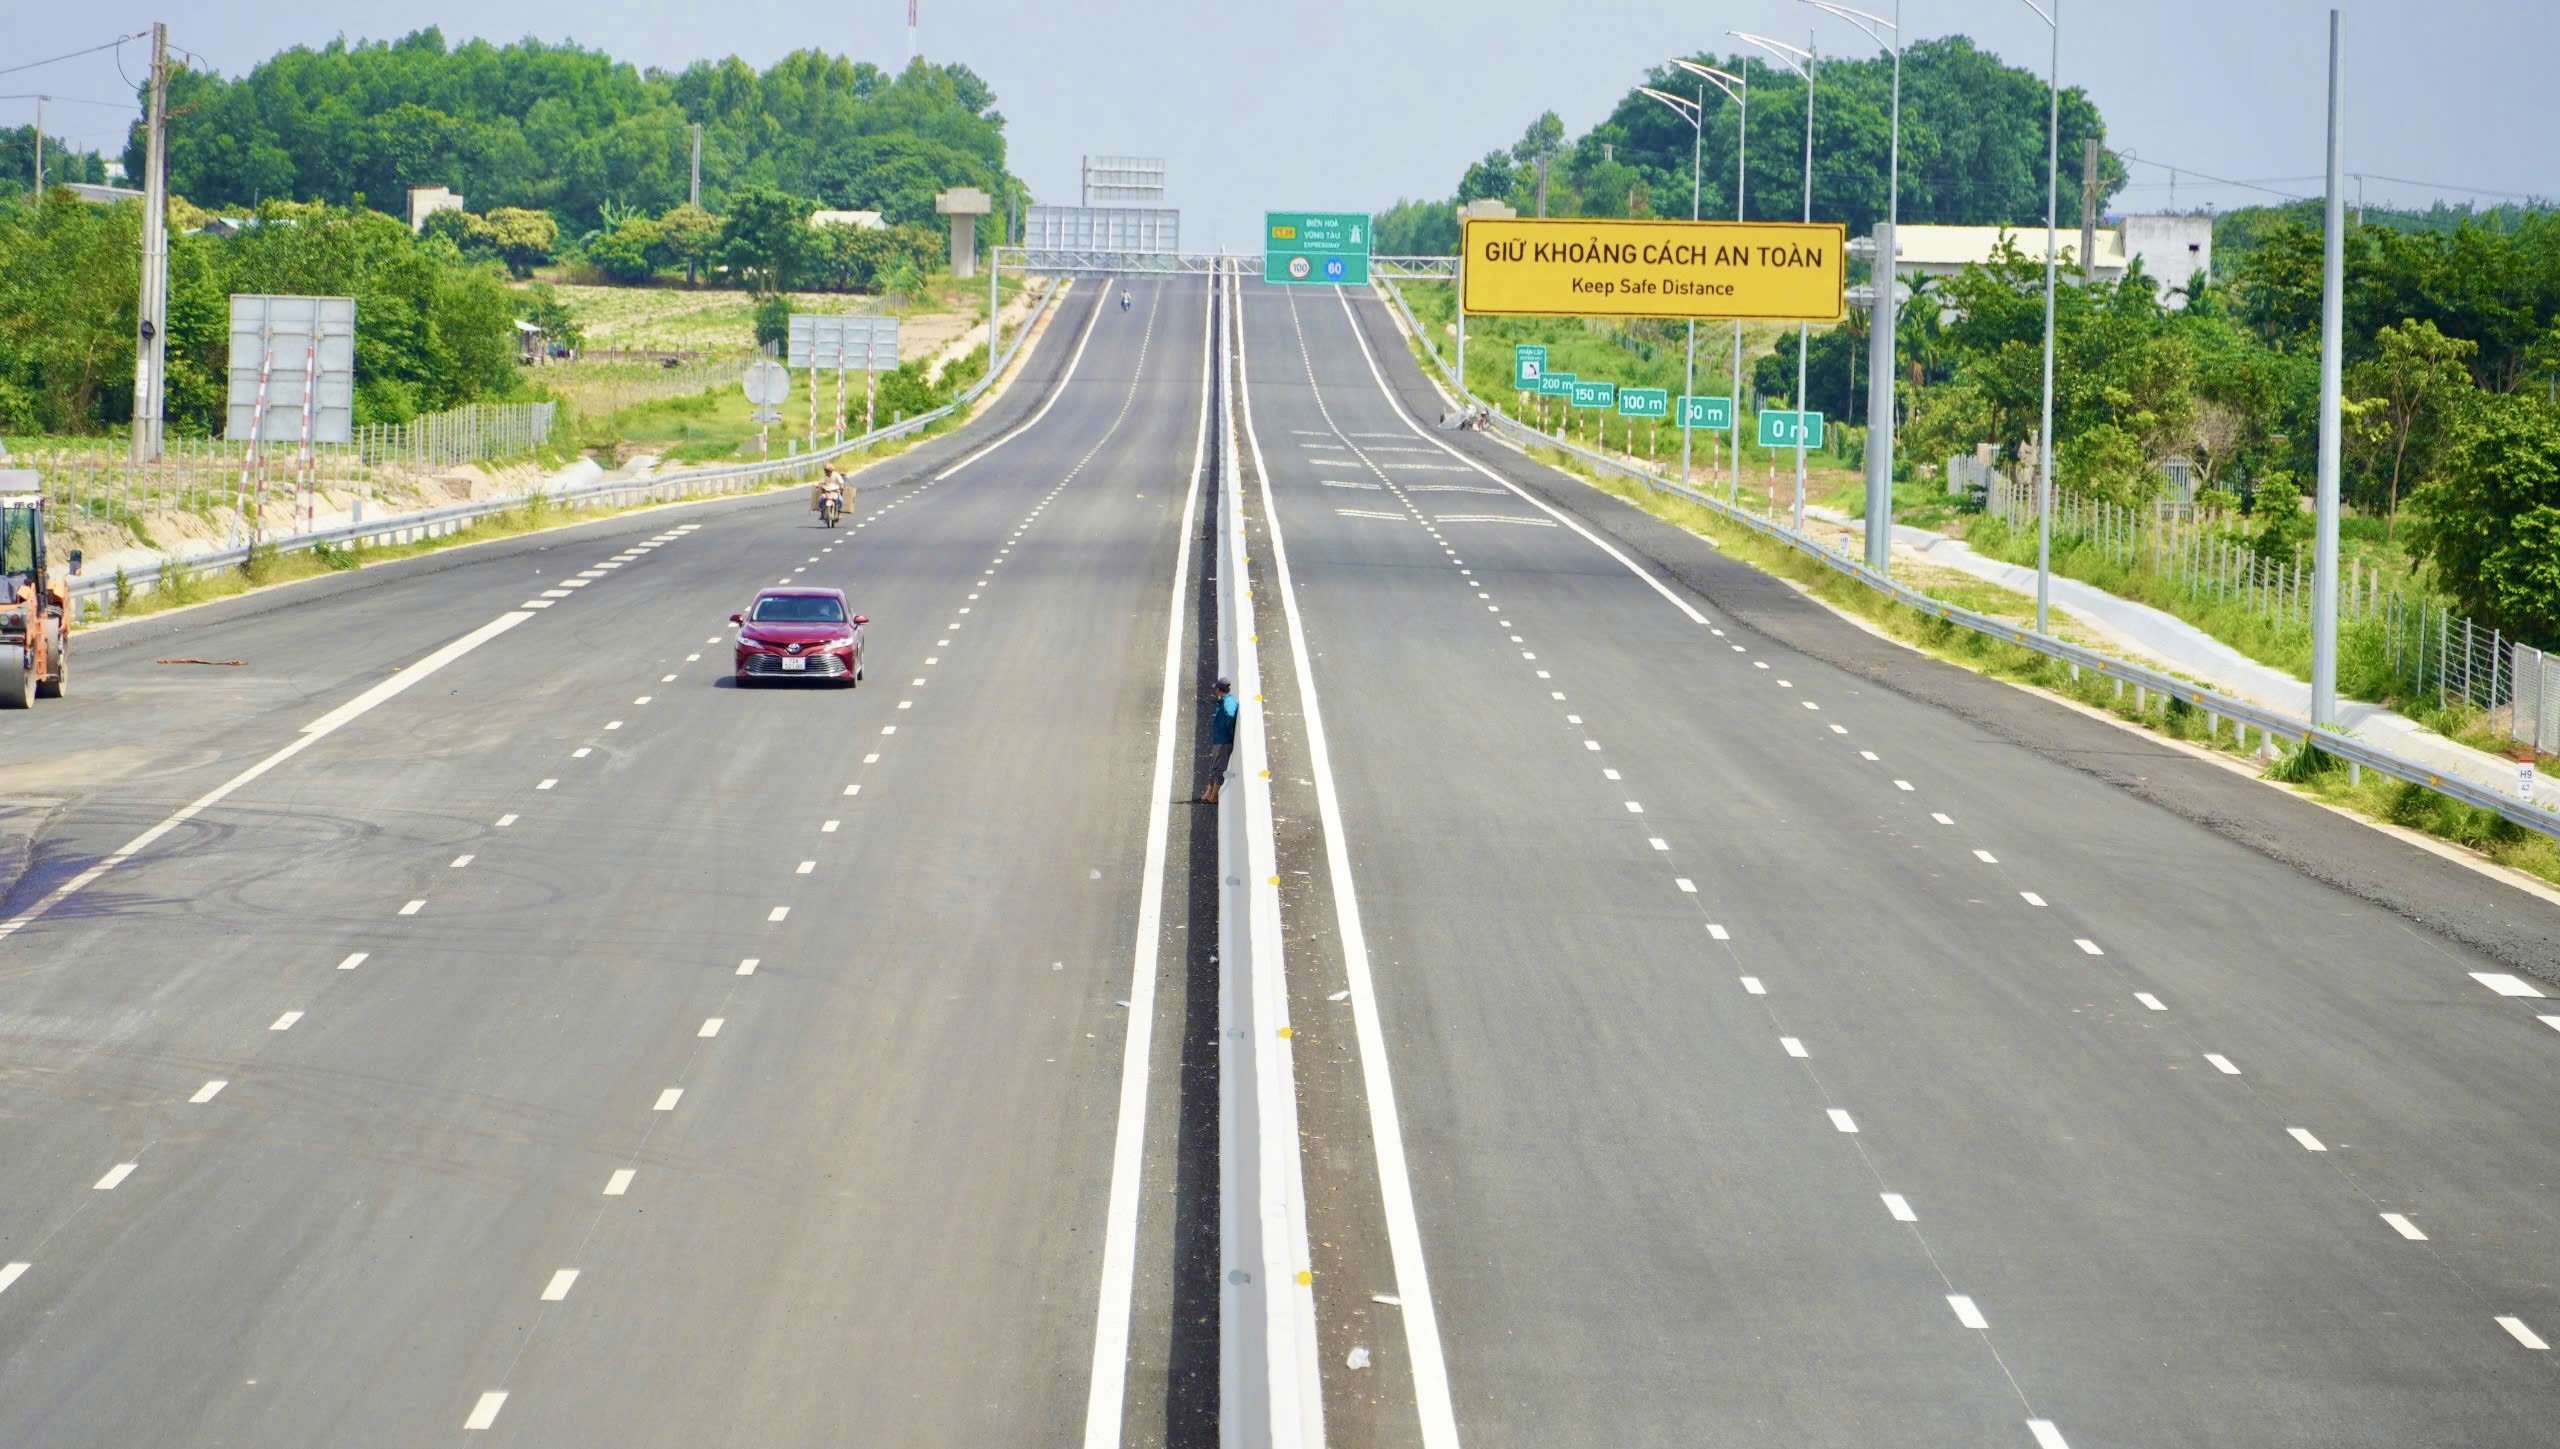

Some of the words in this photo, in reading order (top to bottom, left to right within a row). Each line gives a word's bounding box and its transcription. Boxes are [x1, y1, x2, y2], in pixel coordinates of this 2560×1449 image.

[1306, 218, 1323, 228] BIÊN
[1326, 230, 1341, 240] TÀU
[1485, 238, 1527, 262] GIỮ
[1534, 236, 1637, 264] KHOẢNG
[1642, 240, 1706, 265] CÁCH
[1714, 245, 1749, 267] AN
[1756, 243, 1822, 268] TOÀN
[1293, 263, 1308, 273] 100
[1327, 262, 1342, 275] 60
[1572, 277, 1614, 297] Keep
[1620, 278, 1657, 294] Safe
[1662, 279, 1735, 296] Distance
[1542, 377, 1560, 390] 200
[1562, 381, 1573, 390] m
[1575, 388, 1594, 401] 150
[1598, 391, 1611, 402] m
[1622, 395, 1645, 410] 100
[1648, 399, 1663, 410] m
[1707, 408, 1723, 422] m
[1772, 419, 1785, 438] 0
[2520, 769, 2532, 779] H9
